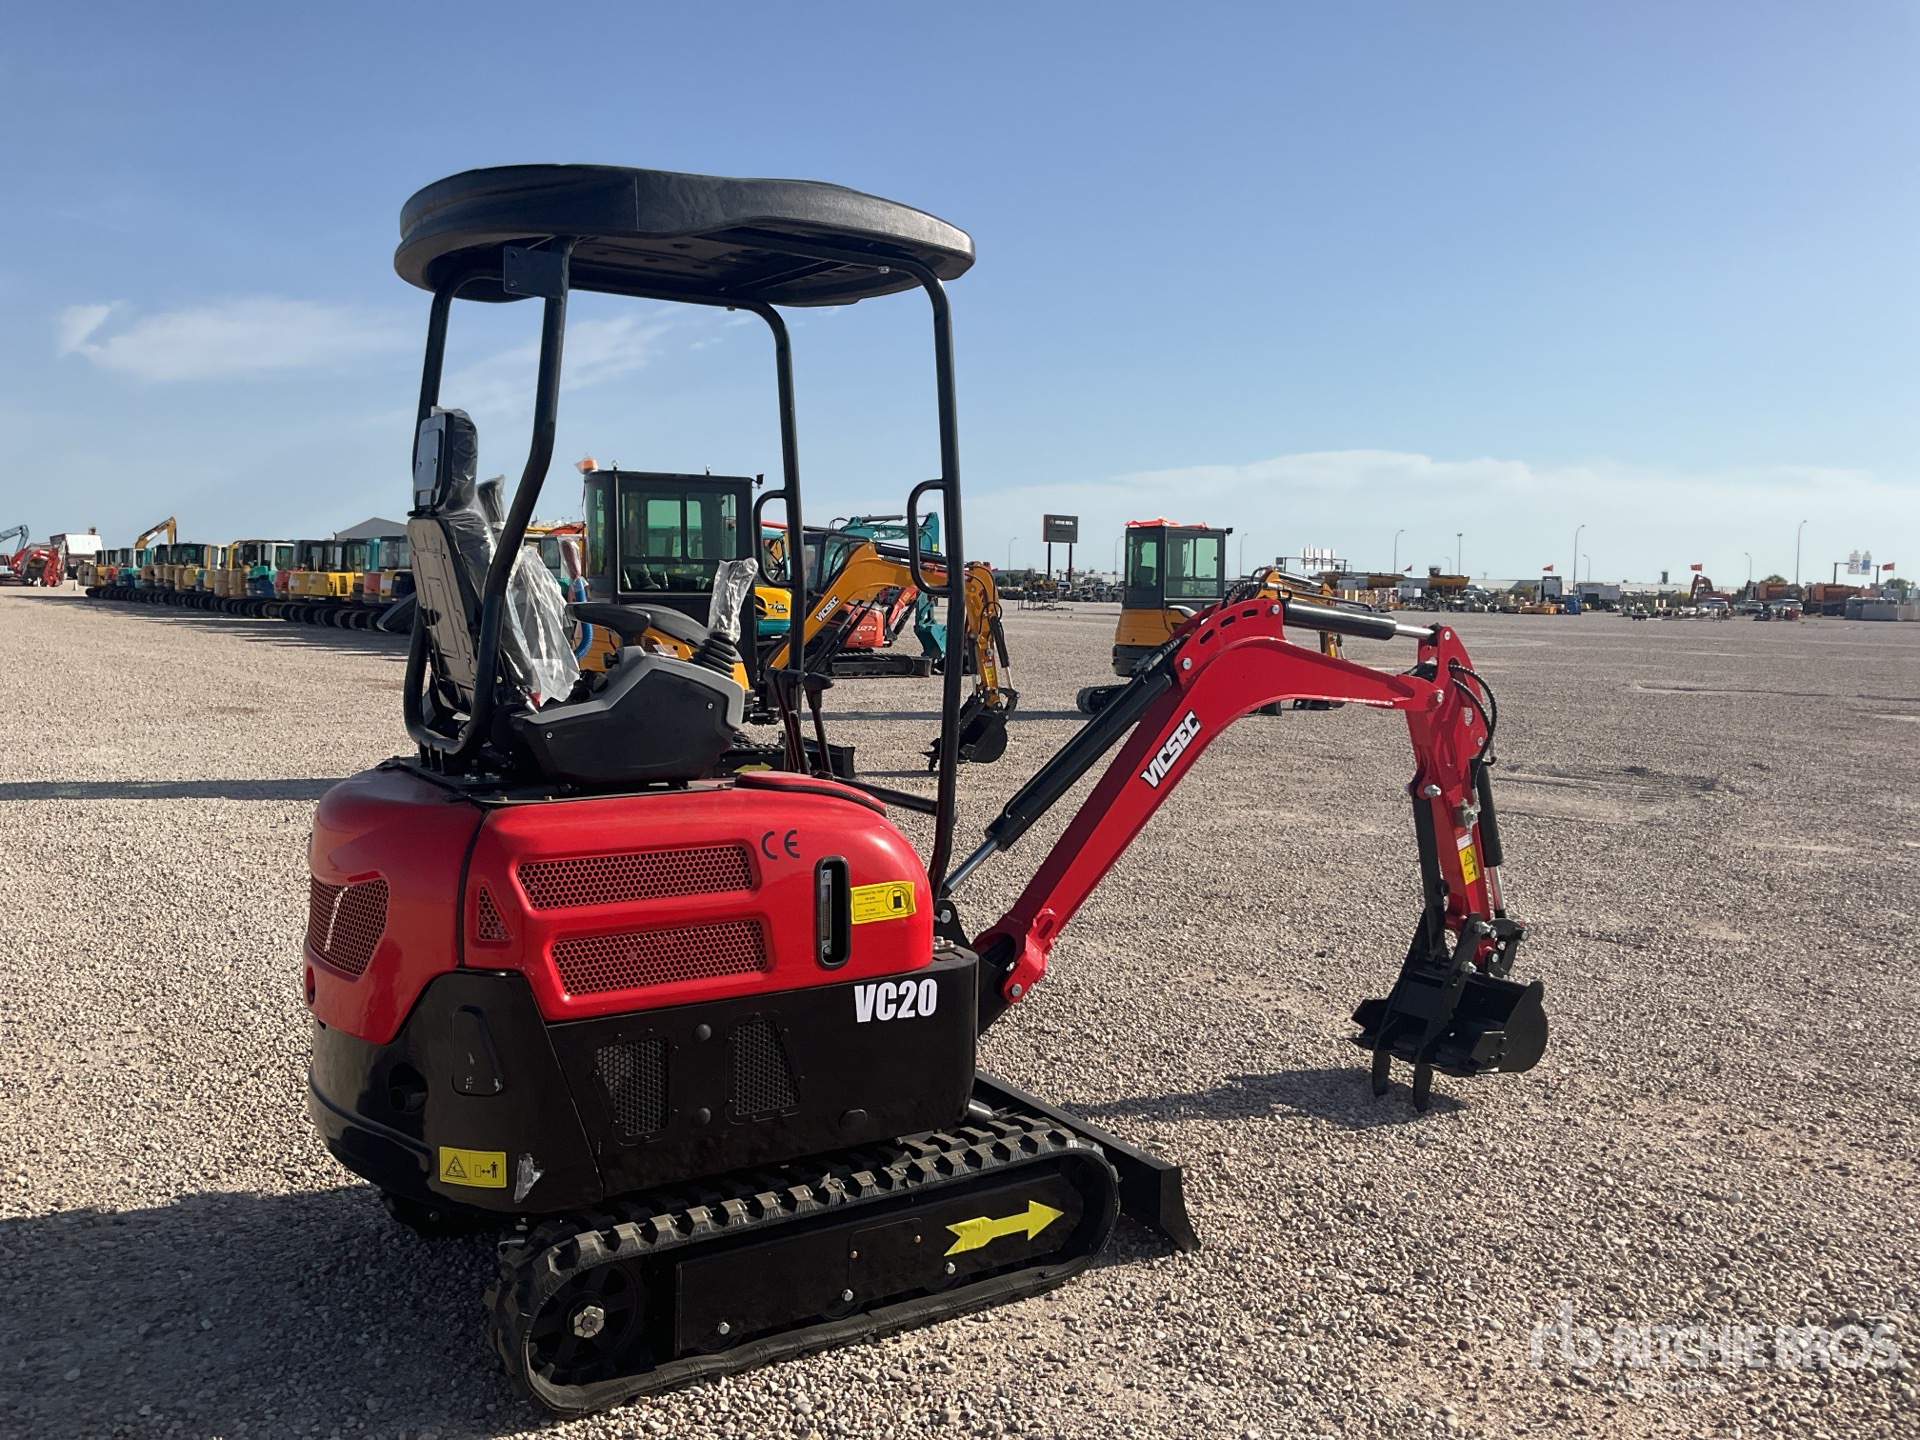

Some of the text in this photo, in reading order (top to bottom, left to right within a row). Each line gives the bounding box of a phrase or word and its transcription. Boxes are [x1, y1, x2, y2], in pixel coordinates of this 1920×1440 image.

[1140, 710, 1202, 788] VICSEC
[761, 829, 800, 860] CE
[854, 978, 938, 1023] VC20
